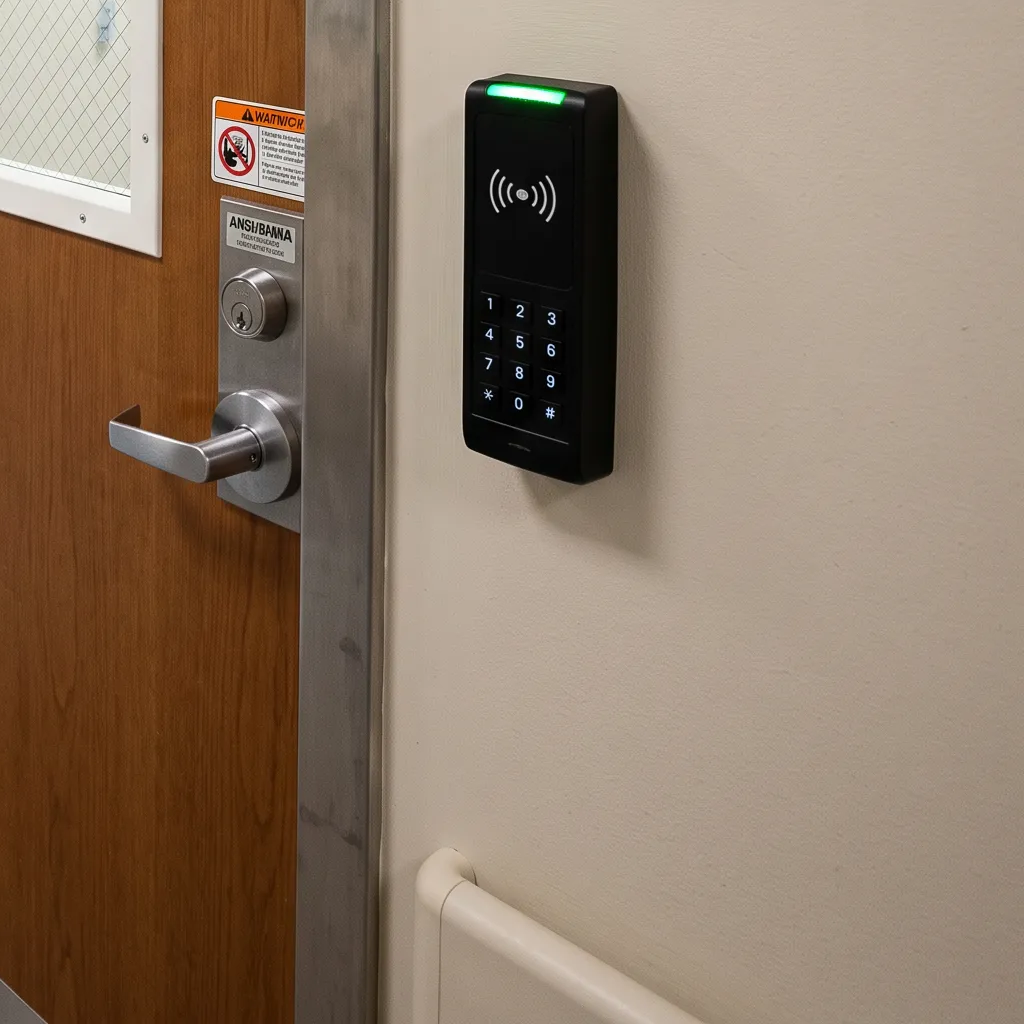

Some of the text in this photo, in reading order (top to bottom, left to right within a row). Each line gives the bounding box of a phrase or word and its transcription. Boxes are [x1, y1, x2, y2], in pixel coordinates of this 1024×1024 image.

[487, 297, 556, 326] 1 2 3
[485, 328, 556, 357] 4 5 6
[484, 357, 555, 388] 7 8 9
[514, 397, 523, 410] 0
